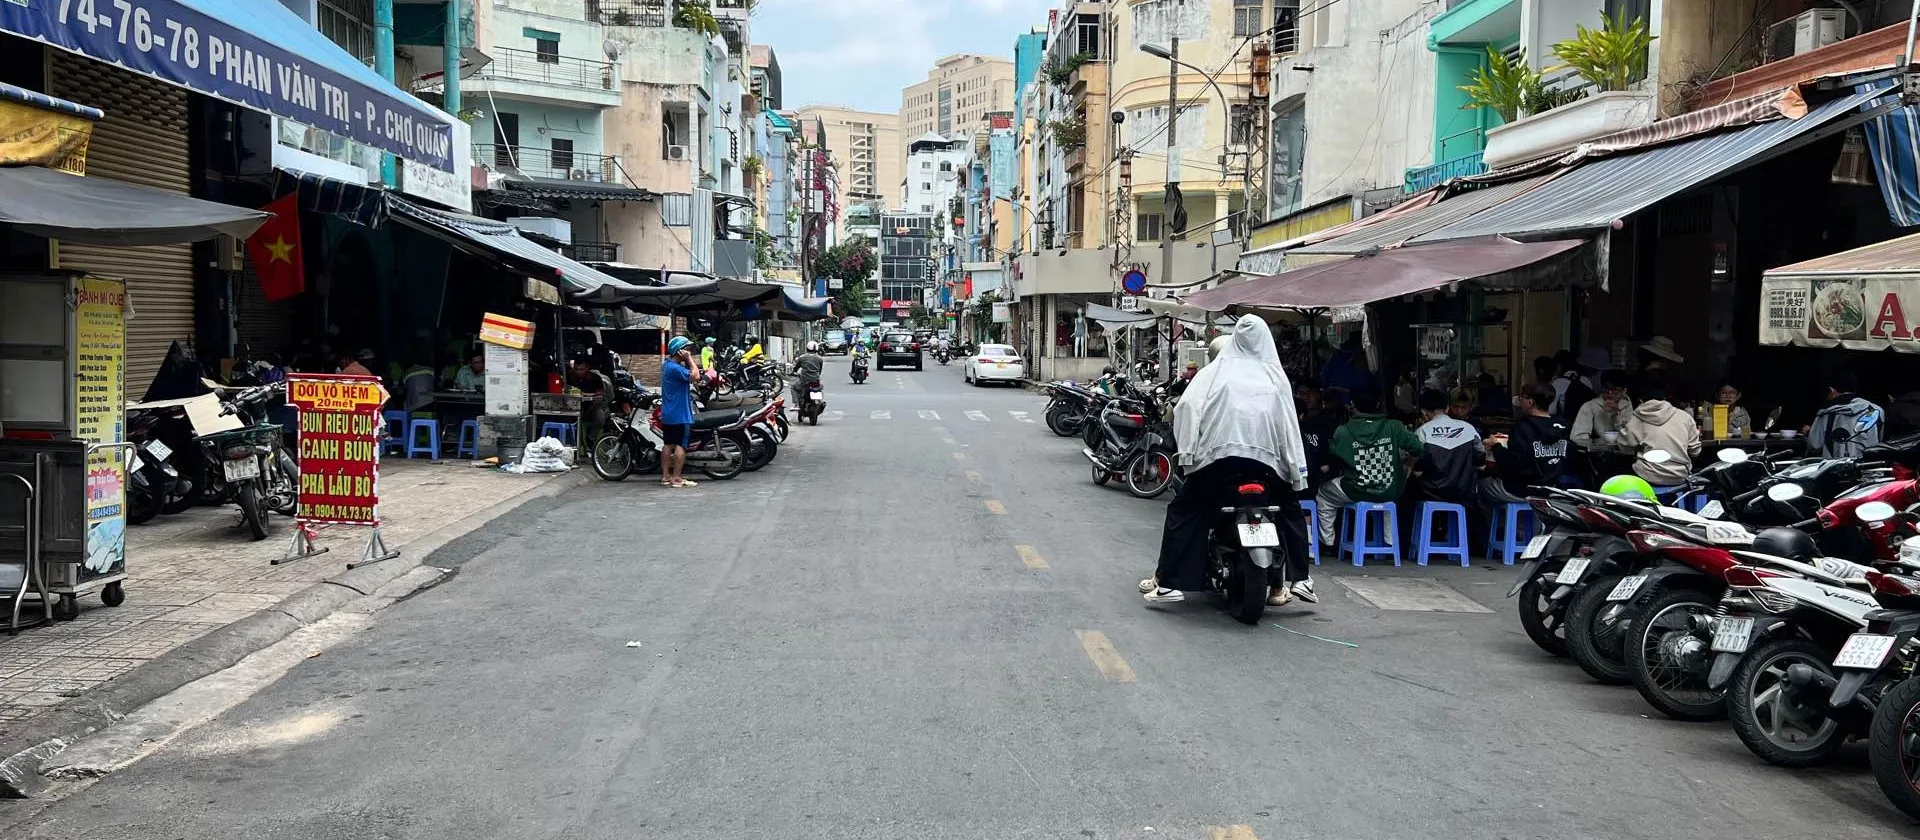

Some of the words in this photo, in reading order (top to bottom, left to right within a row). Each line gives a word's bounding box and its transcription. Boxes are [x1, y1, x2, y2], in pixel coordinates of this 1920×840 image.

[209, 35, 272, 95] PHAN
[277, 62, 317, 111] VĂN
[321, 81, 350, 131] TRỊ
[366, 100, 381, 134] P.
[385, 109, 413, 152] CHỢ
[317, 399, 331, 407] 20
[352, 415, 372, 435] CUA
[301, 438, 339, 459] CANH
[344, 436, 372, 461] BÚN
[301, 468, 325, 494] PHÁ
[328, 467, 351, 496] LẤU
[354, 471, 371, 497] BÒ
[315, 504, 372, 520] 0904.74.73.73
